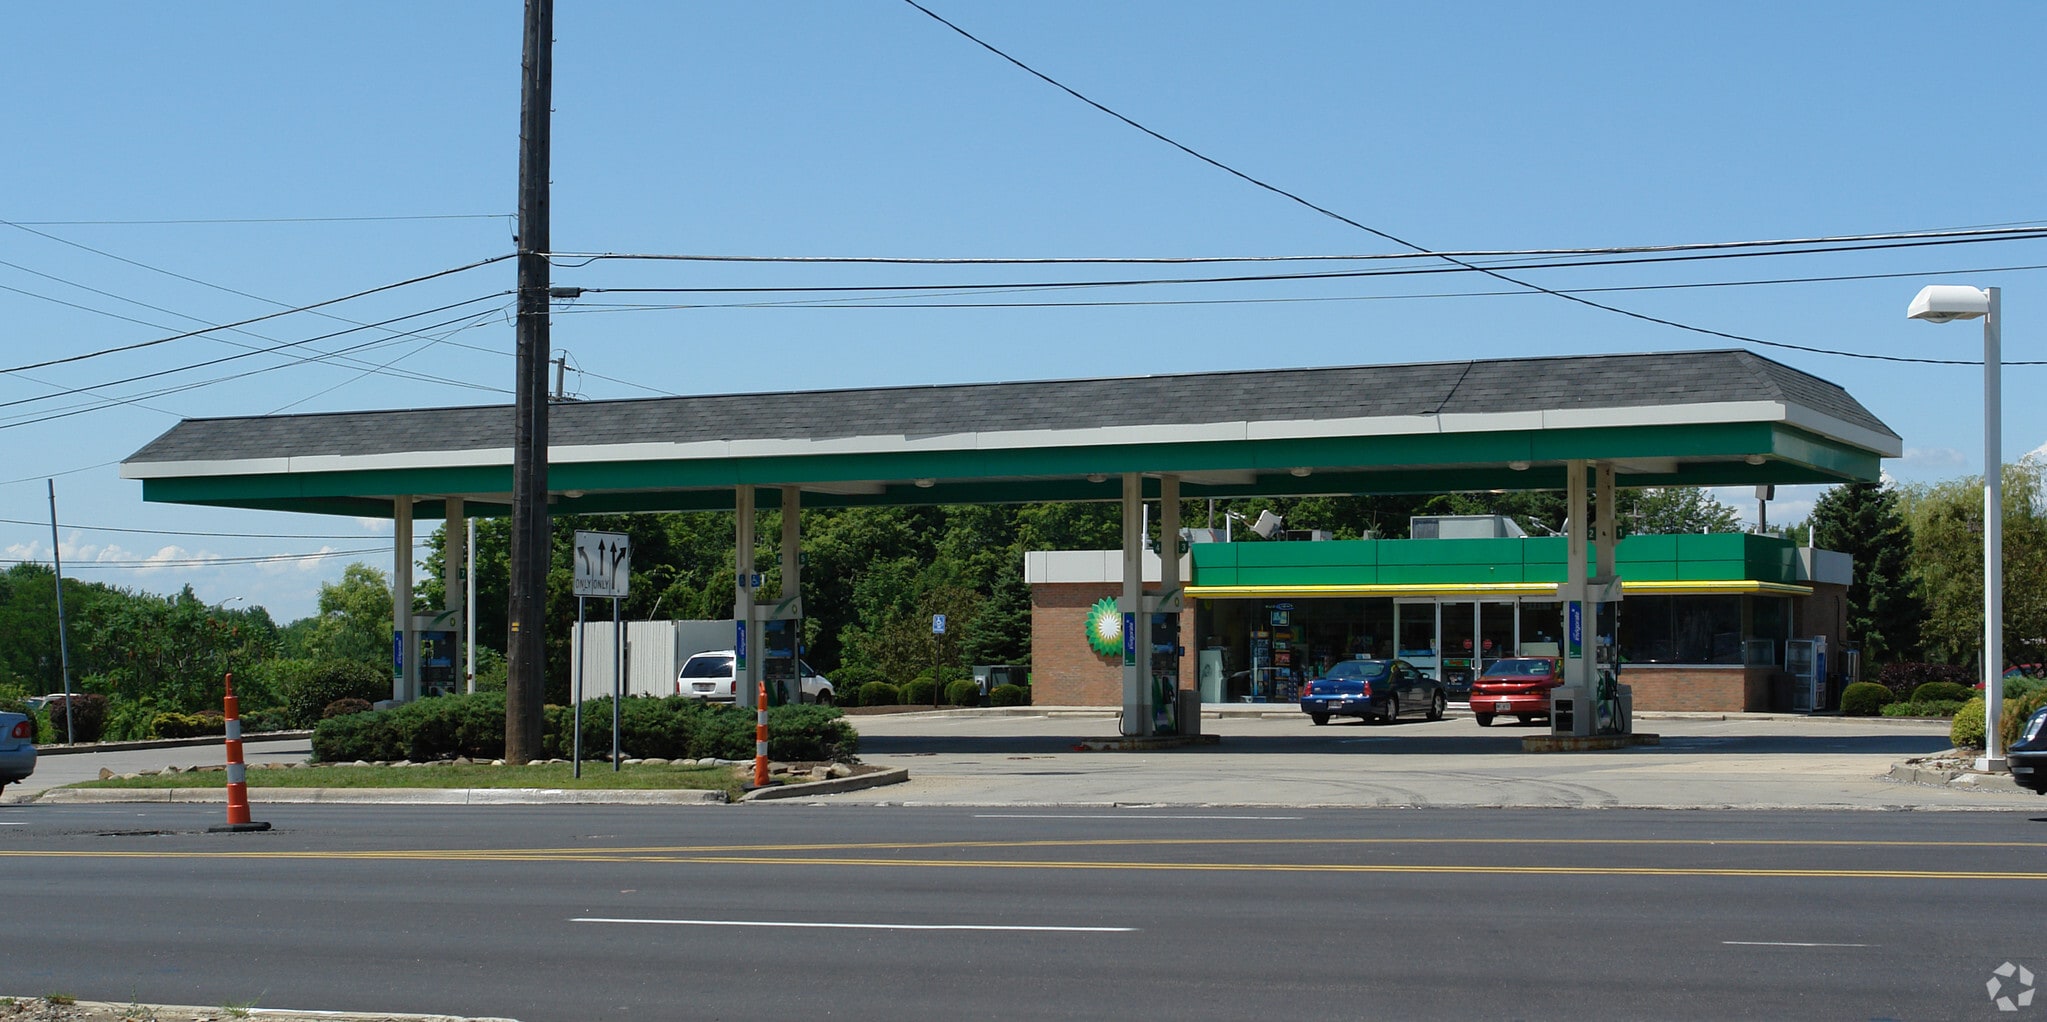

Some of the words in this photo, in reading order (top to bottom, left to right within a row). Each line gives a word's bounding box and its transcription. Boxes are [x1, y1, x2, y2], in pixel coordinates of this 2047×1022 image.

[1588, 529, 1594, 538] 2
[575, 579, 591, 589] ONLY
[593, 580, 609, 590] ONLY
